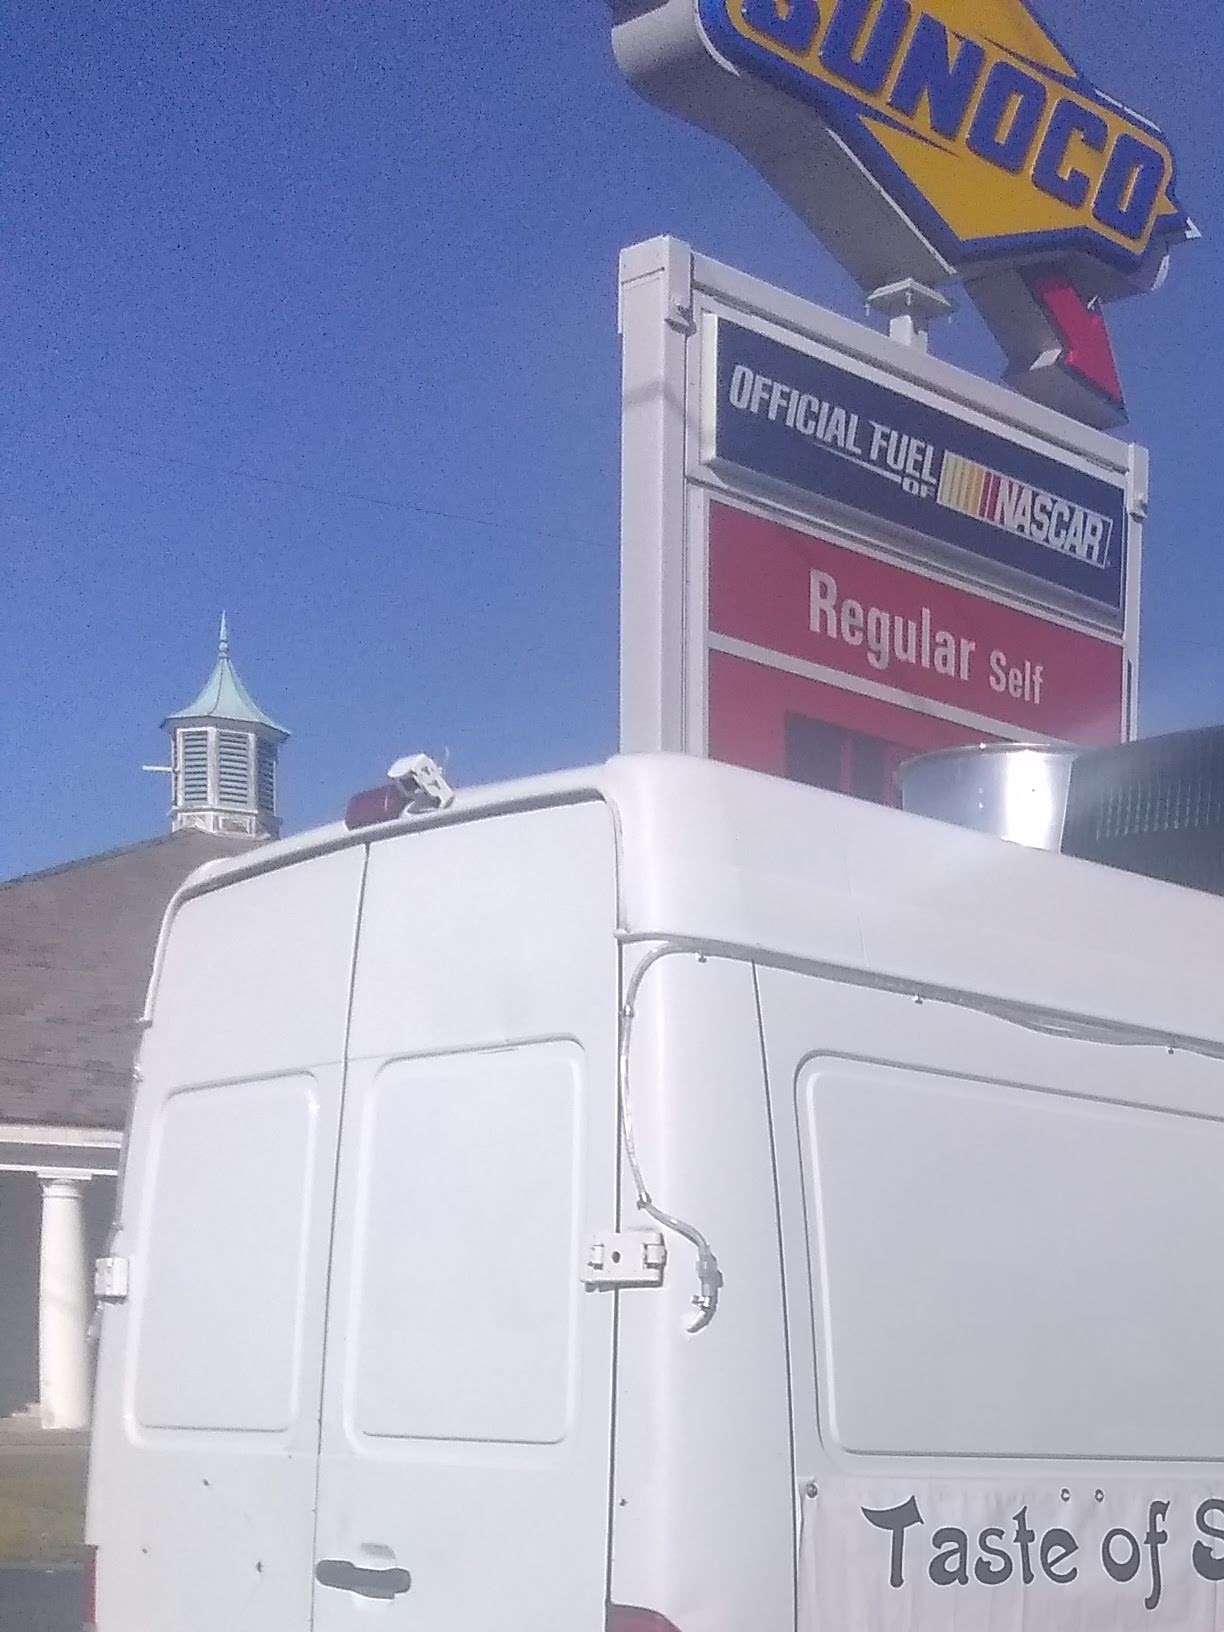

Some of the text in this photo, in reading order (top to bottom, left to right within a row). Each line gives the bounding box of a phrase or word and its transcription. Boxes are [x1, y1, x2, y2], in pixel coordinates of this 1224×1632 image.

[729, 364, 938, 485] OFFICIAL FUEL
[902, 476, 936, 498] OF
[995, 476, 1103, 563] NASCAR
[809, 567, 1044, 705] Regular Self
[860, 1495, 1080, 1588] Taste
[1101, 1499, 1170, 1611] of
